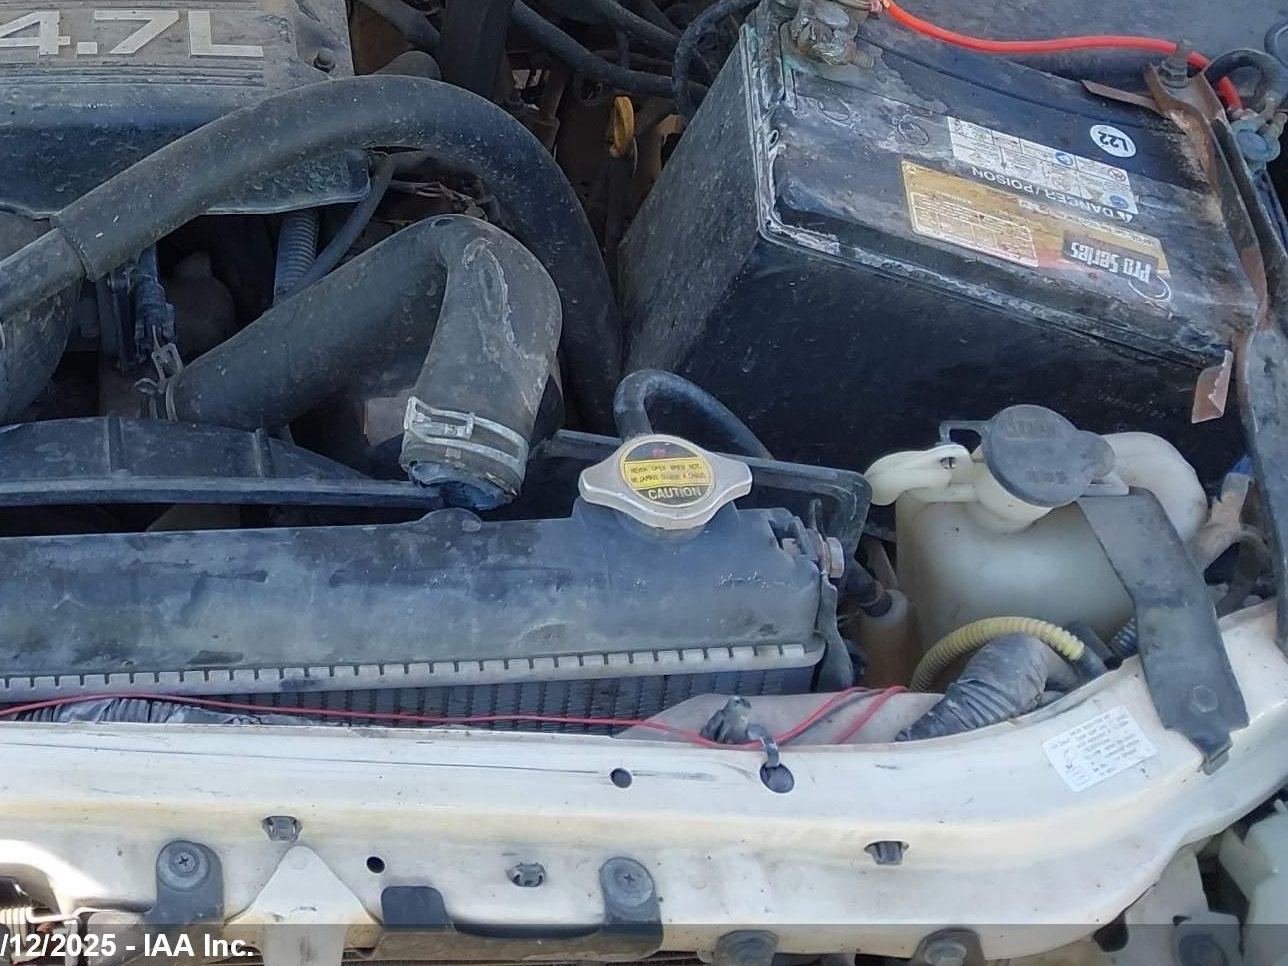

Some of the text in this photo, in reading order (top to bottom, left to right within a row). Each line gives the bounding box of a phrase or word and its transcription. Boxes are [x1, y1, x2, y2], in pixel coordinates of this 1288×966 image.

[972, 168, 1034, 194] POISON
[1045, 191, 1114, 217] DANGER
[1070, 241, 1152, 283] Pro Series
[648, 487, 702, 500] CAUTION
